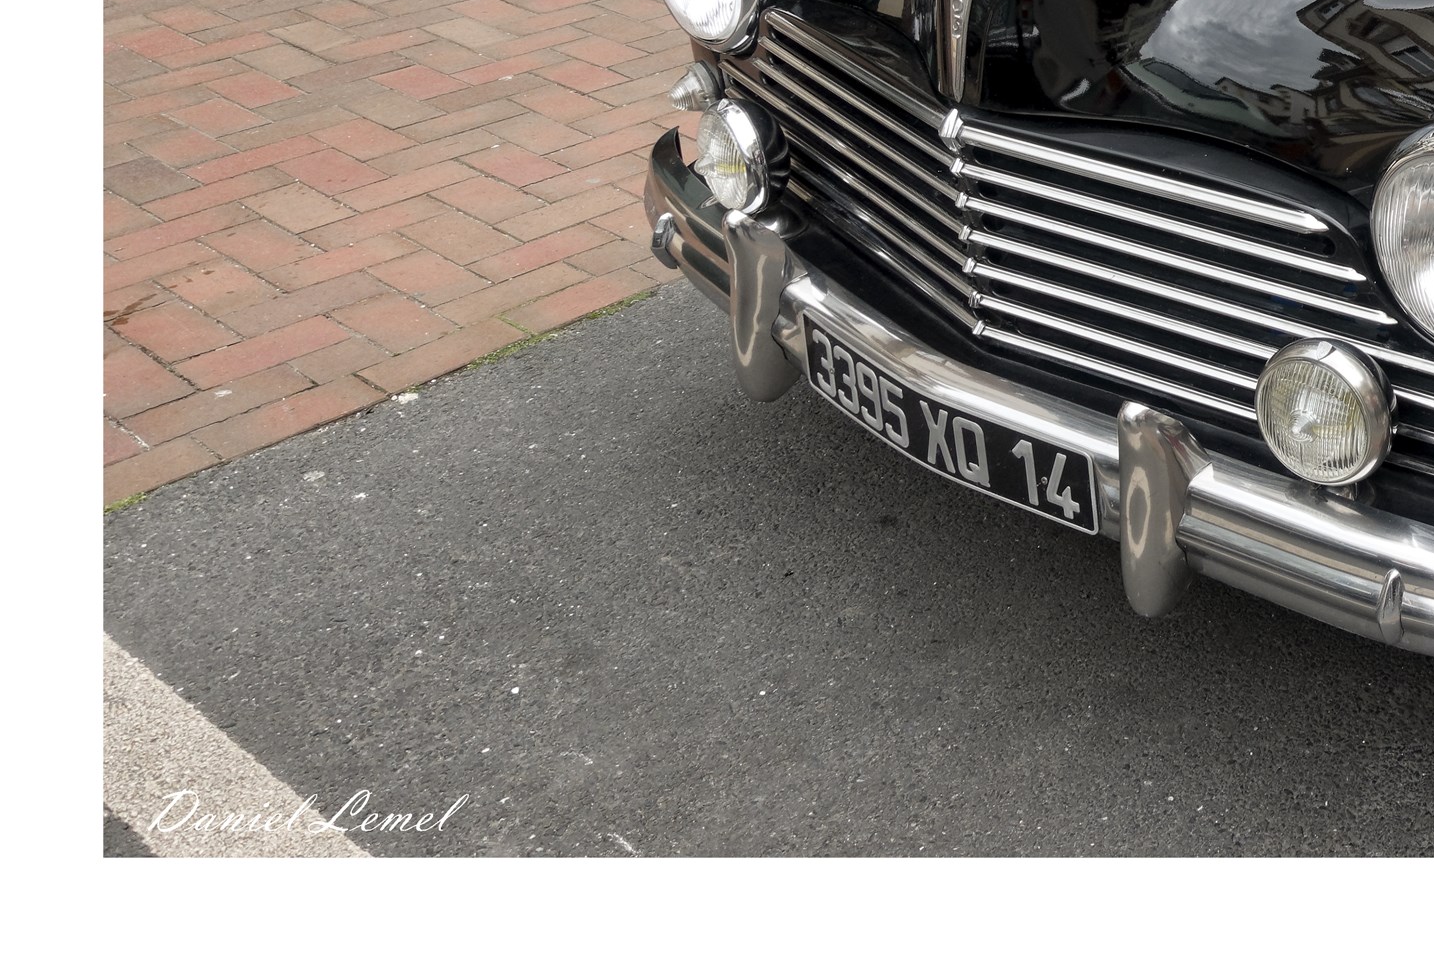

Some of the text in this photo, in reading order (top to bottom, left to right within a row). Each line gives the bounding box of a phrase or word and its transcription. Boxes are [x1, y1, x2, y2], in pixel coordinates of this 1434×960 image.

[811, 328, 1081, 520] 3395 XQ 14
